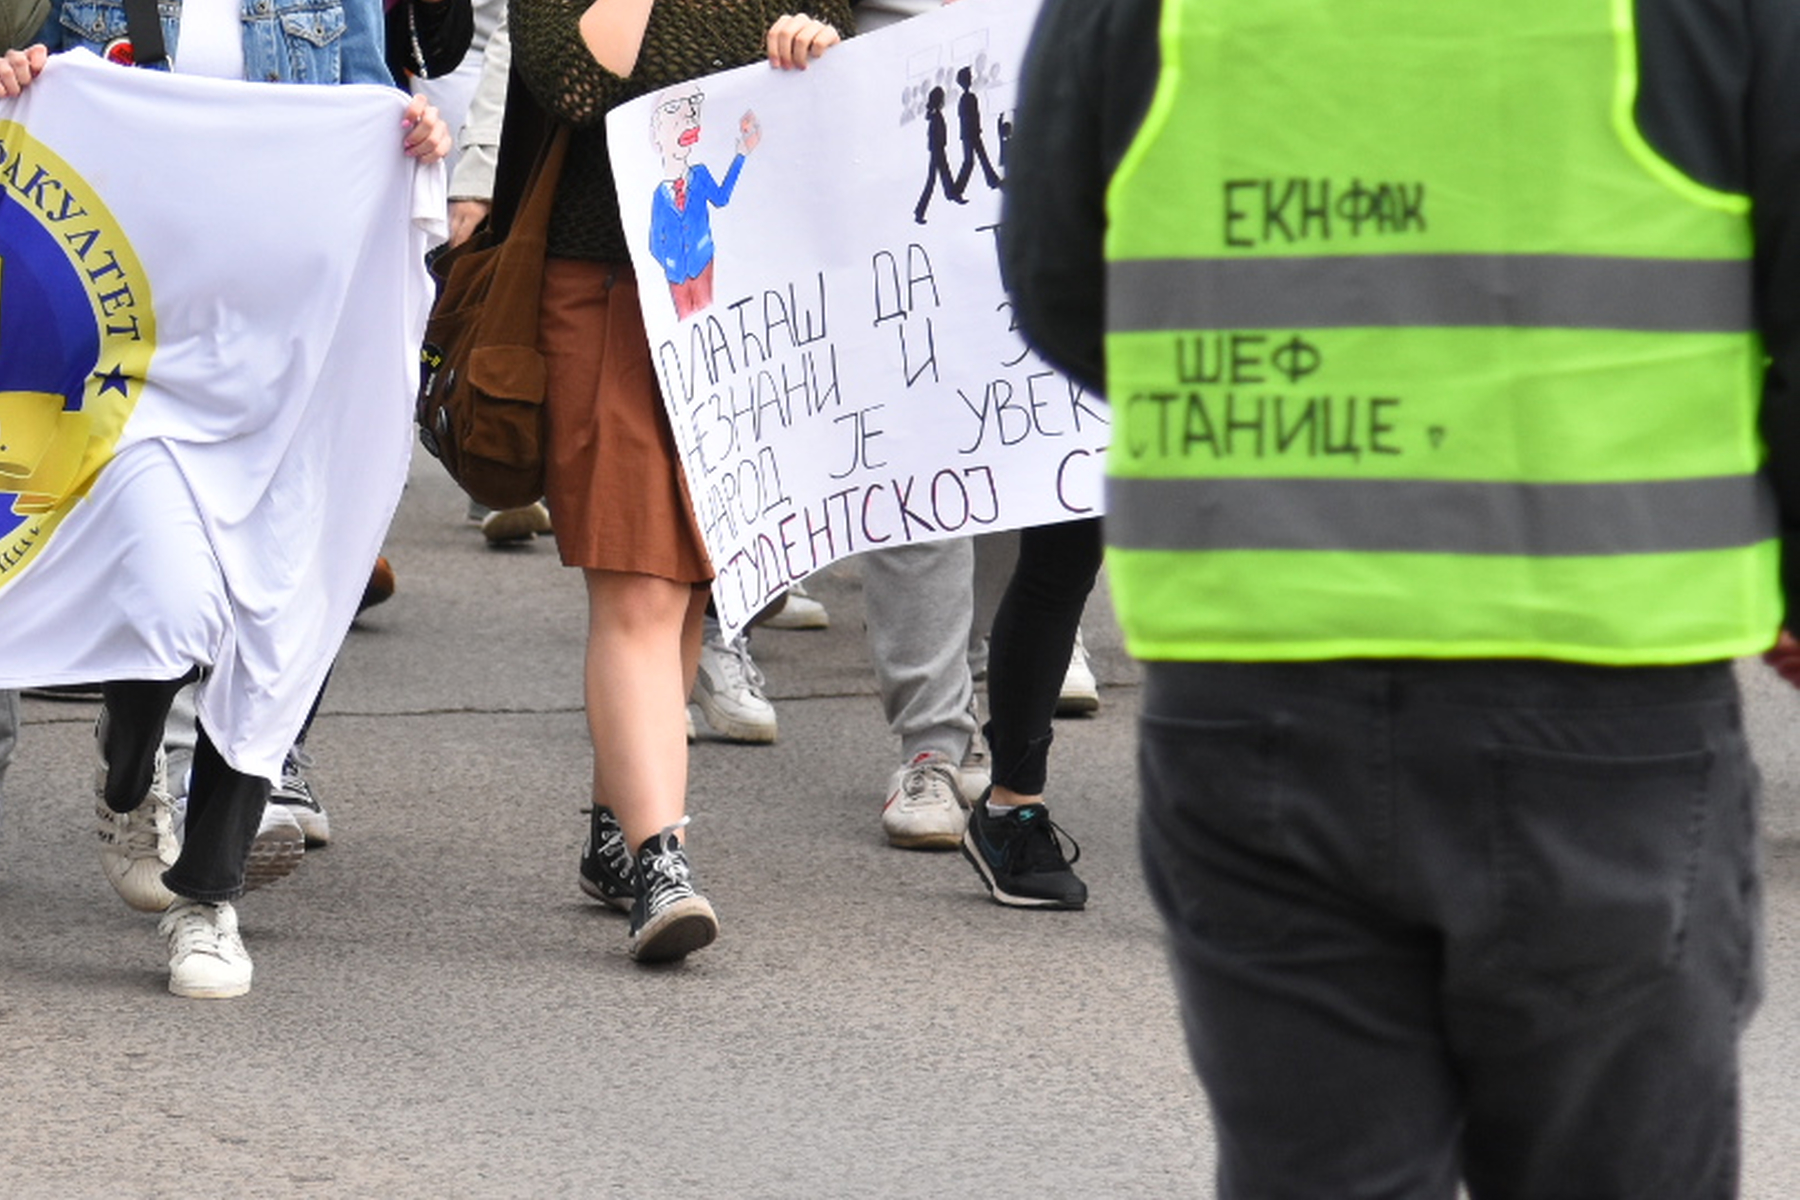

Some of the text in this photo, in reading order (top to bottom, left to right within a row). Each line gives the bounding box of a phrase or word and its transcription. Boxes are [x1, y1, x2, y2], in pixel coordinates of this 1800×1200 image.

[659, 272, 827, 416] ПЛАЋАШ
[872, 243, 940, 328] ДА
[899, 317, 940, 388] И
[1175, 335, 1322, 385] ШЕФ
[956, 371, 1111, 454] УВЕК
[1126, 391, 1404, 463] СТАНИЦЕ
[715, 465, 1000, 630] СТУДЕНТСКОЈ
